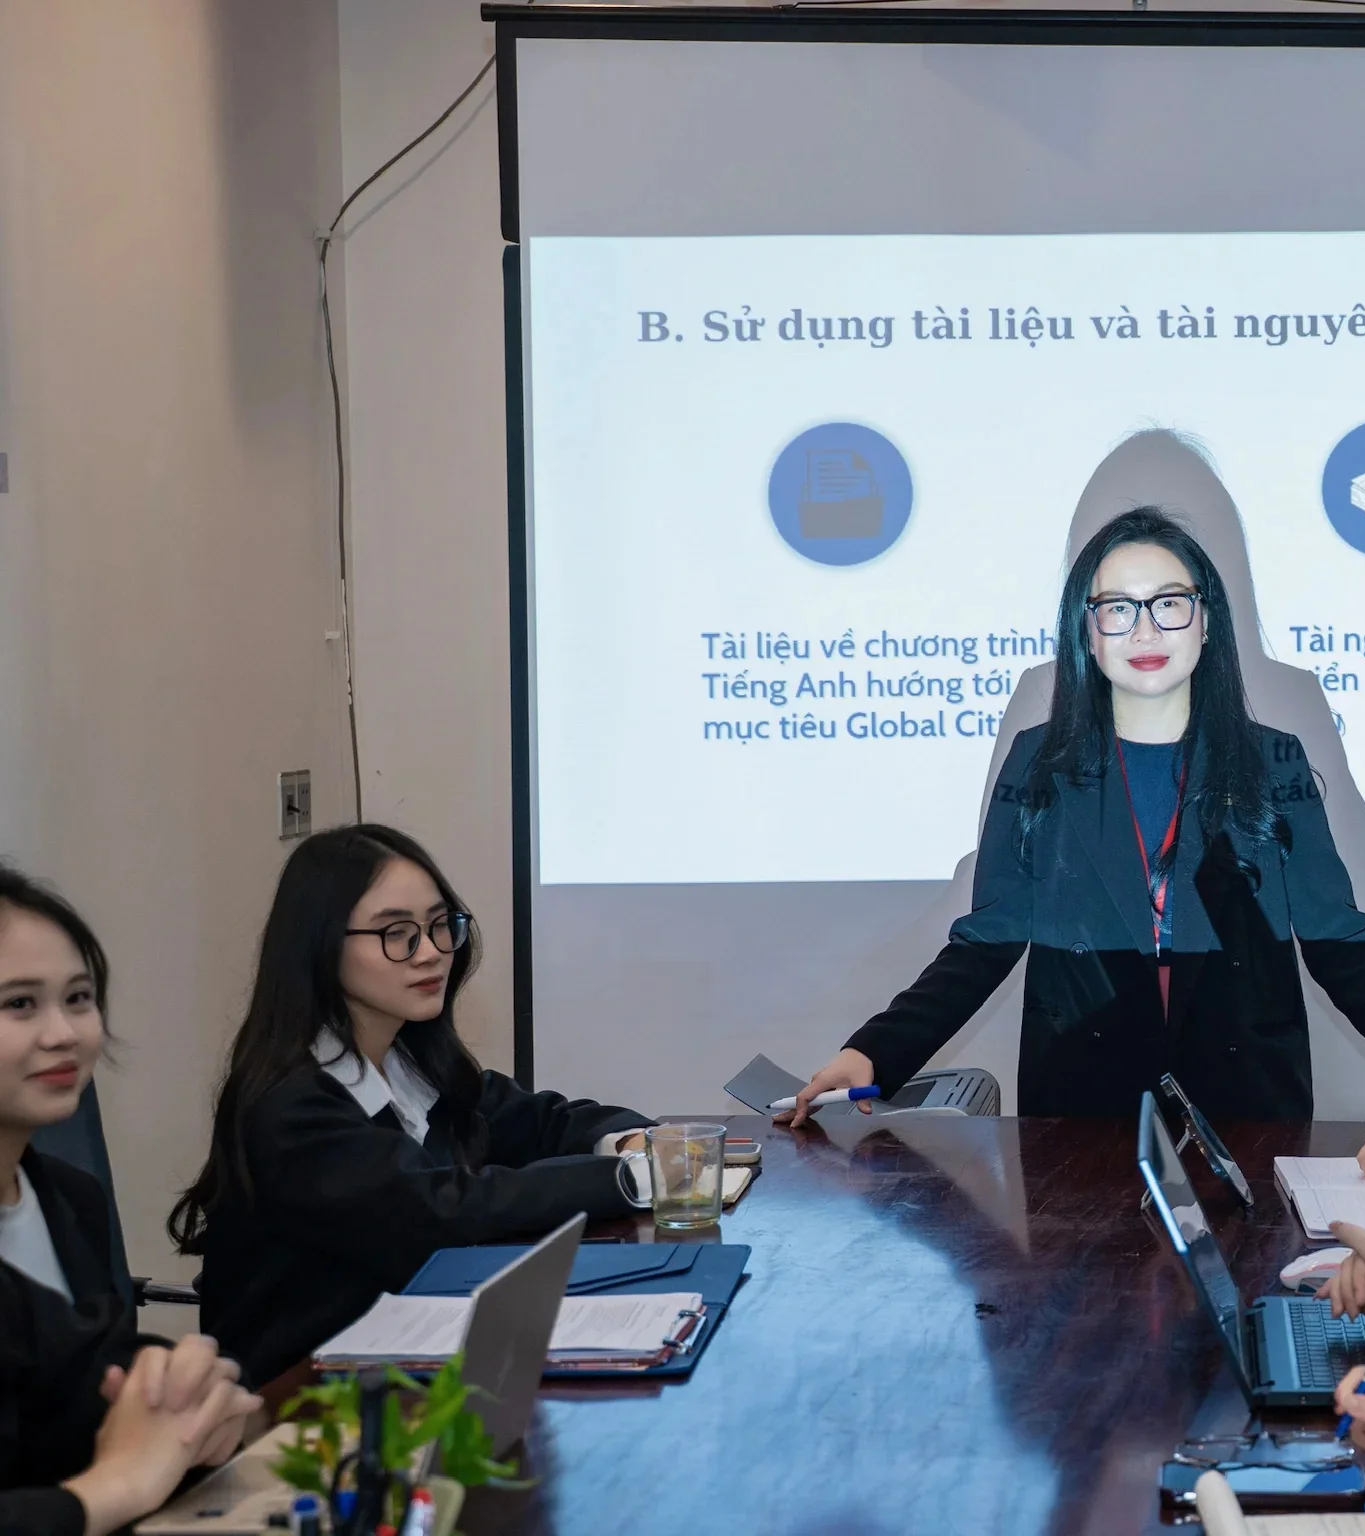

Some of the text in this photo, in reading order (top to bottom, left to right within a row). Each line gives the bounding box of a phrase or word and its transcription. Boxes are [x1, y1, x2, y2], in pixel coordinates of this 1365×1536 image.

[637, 311, 684, 343] B.
[703, 305, 766, 342] Sử
[778, 308, 895, 349] dụng
[911, 306, 973, 340] tài
[988, 307, 1075, 348] liệu
[1089, 305, 1141, 339] và
[1156, 304, 1218, 339] tài
[701, 628, 1057, 665] Tài liệu về chương trình
[1289, 625, 1334, 653] Tài
[702, 668, 1012, 707] Tiếng Anh hướng tới
[703, 720, 770, 745] mục
[779, 711, 837, 740] tiêu
[846, 709, 947, 740] Global
